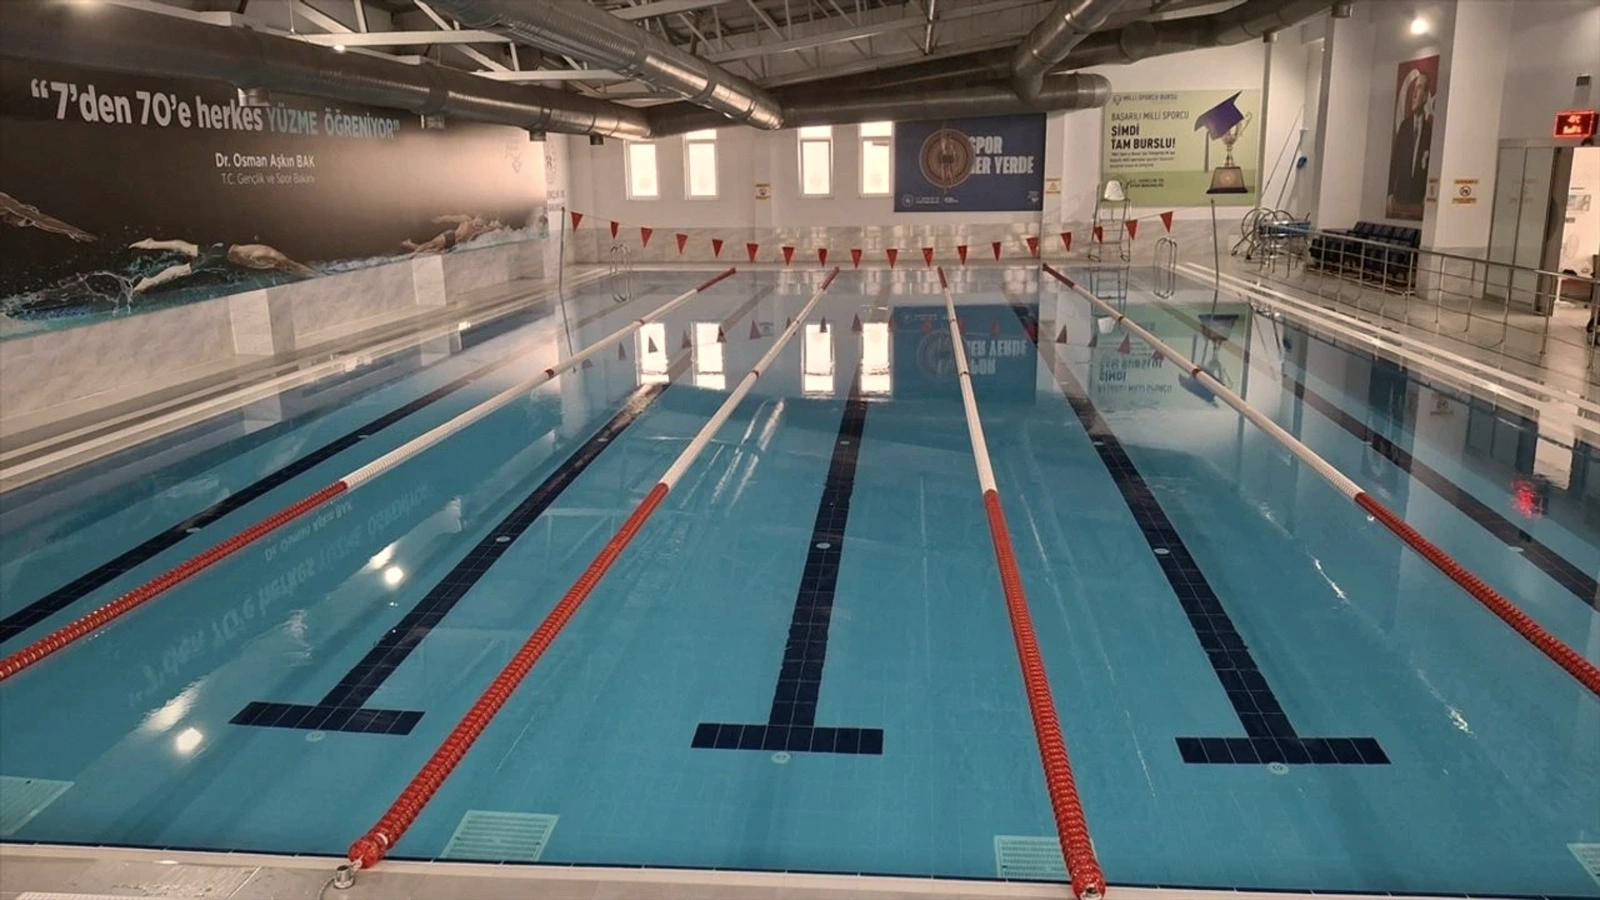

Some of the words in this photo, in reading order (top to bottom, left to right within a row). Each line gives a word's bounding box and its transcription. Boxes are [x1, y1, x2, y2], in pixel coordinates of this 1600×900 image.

[136, 90, 192, 128] 70'e
[195, 95, 263, 131] herkes
[266, 103, 319, 135] YÜZME
[1111, 139, 1131, 150] TAM
[1133, 137, 1176, 149] BURSLU!
[215, 152, 231, 167] Dr.
[233, 153, 268, 168] Osman
[270, 153, 295, 169] Aşkın
[296, 154, 316, 168] BAK
[994, 156, 1034, 174] YERDE
